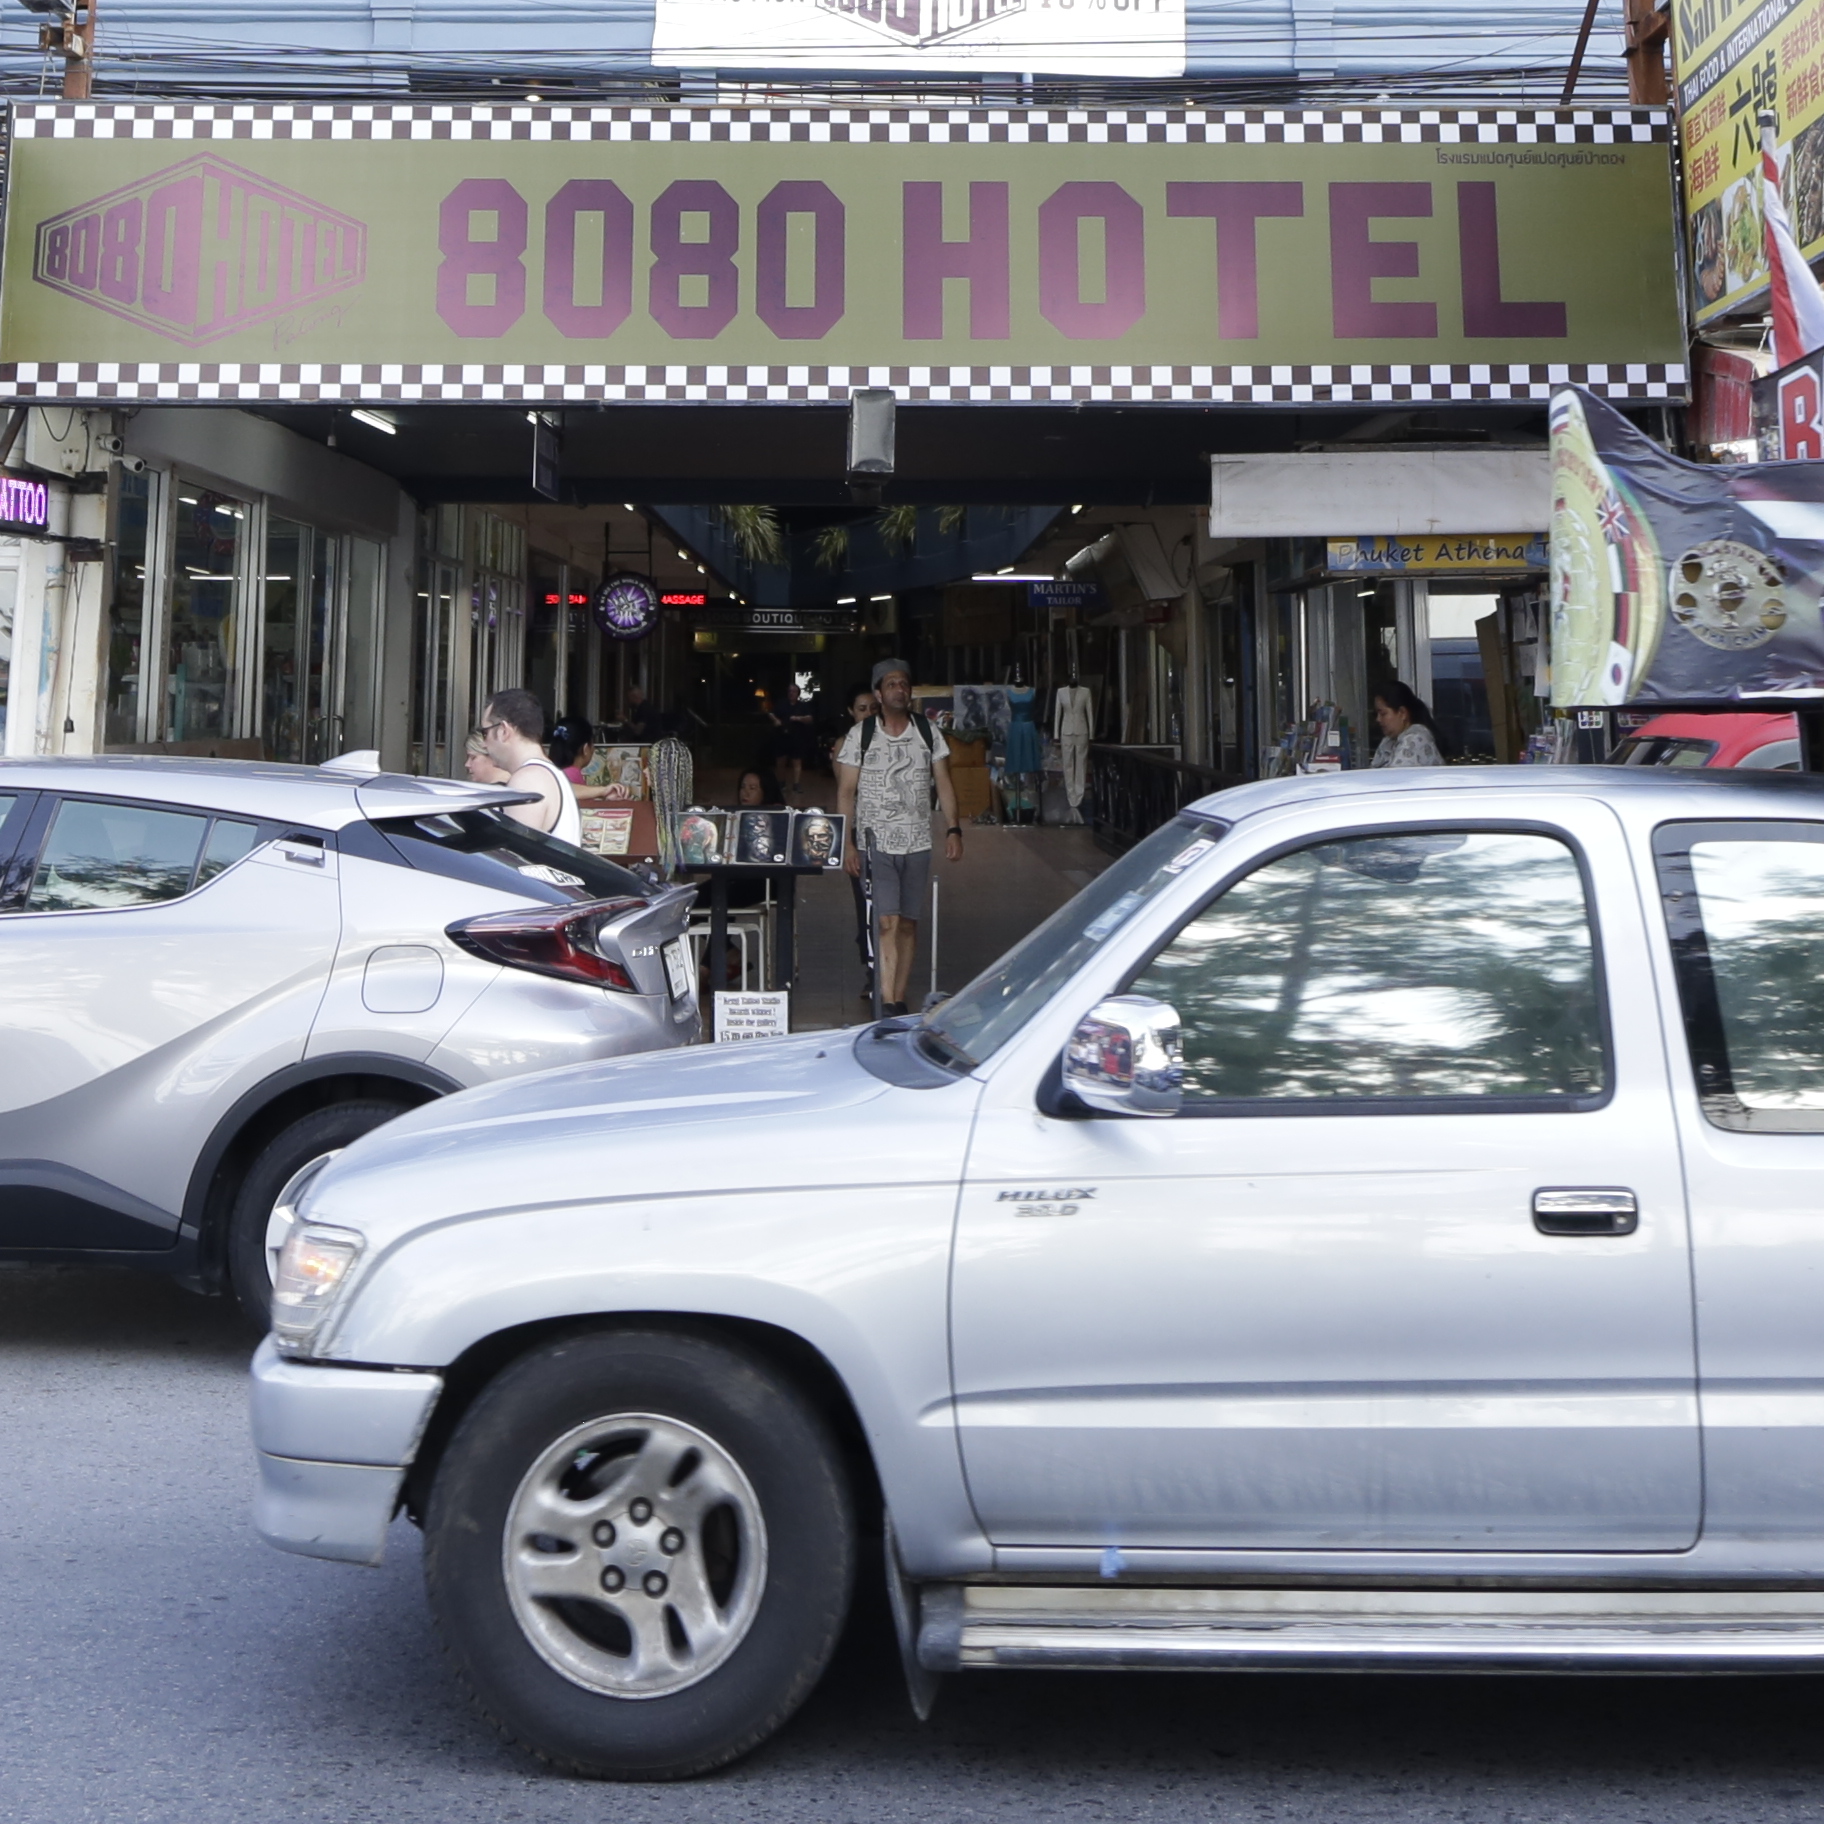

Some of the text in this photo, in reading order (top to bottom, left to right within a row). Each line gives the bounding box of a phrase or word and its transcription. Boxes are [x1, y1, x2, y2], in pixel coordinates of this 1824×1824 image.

[1683, 80, 1699, 107] THAI
[1699, 61, 1719, 93] FOOD
[1719, 49, 1727, 73] &
[45, 164, 361, 333] 8080 HOTEL
[434, 178, 1569, 340] 8080 HOTEL
[1337, 541, 1526, 564] Phuket Athena
[1033, 583, 1097, 594] MARTIN'S
[1047, 596, 1081, 605] TAILOR
[995, 1187, 1098, 1203] HILUX
